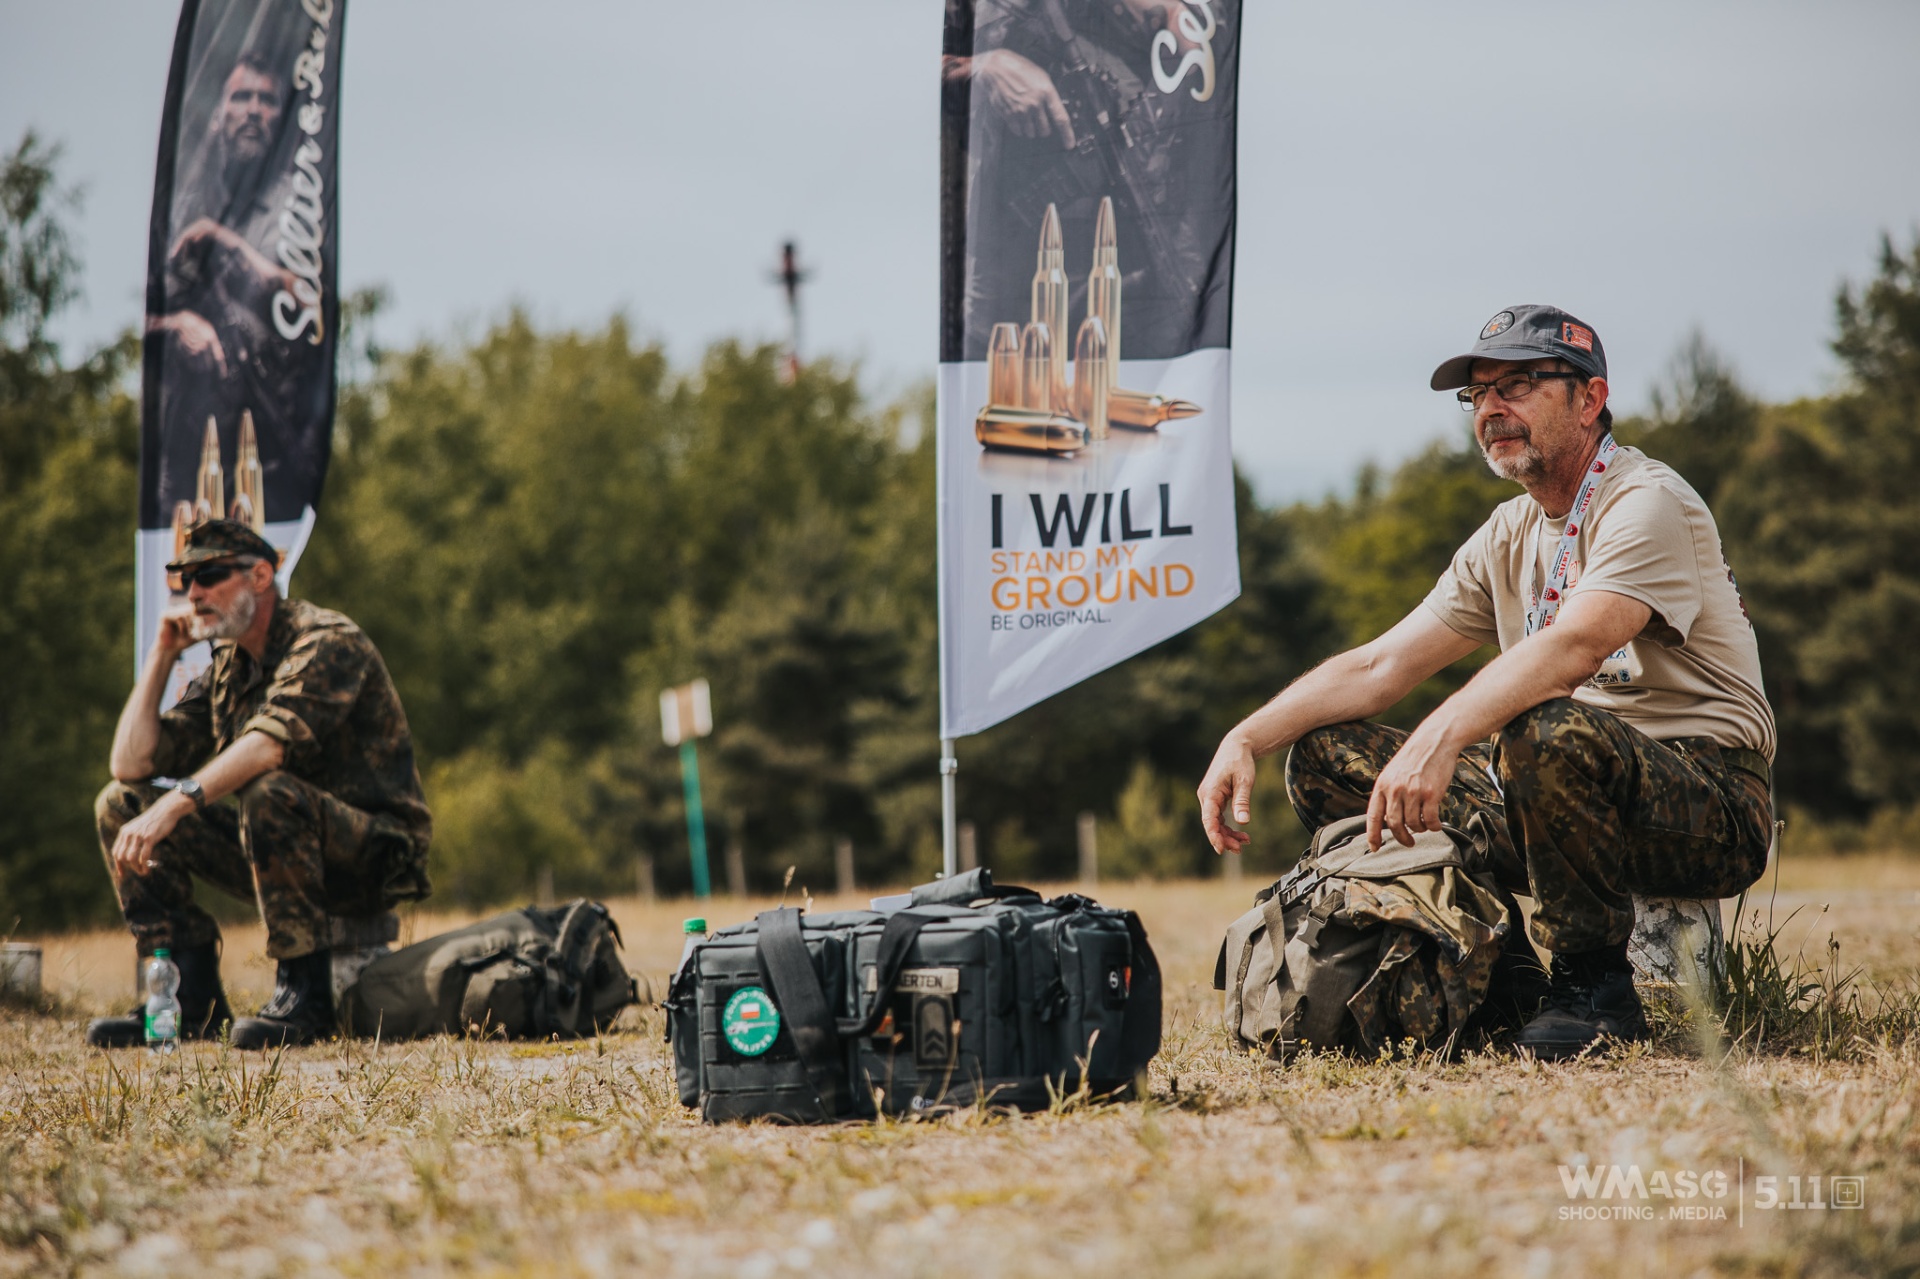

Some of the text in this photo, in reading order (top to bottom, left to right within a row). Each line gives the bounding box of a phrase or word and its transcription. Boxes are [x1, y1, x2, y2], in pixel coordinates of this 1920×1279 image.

[1151, 0, 1216, 102] Se
[271, 137, 325, 346] Sellier
[991, 483, 1193, 549] I WILL
[990, 544, 1140, 575] STAND MY
[990, 563, 1196, 612] GROUND
[991, 608, 1112, 631] BE ORIGINAL.
[902, 974, 943, 989] ERTEN
